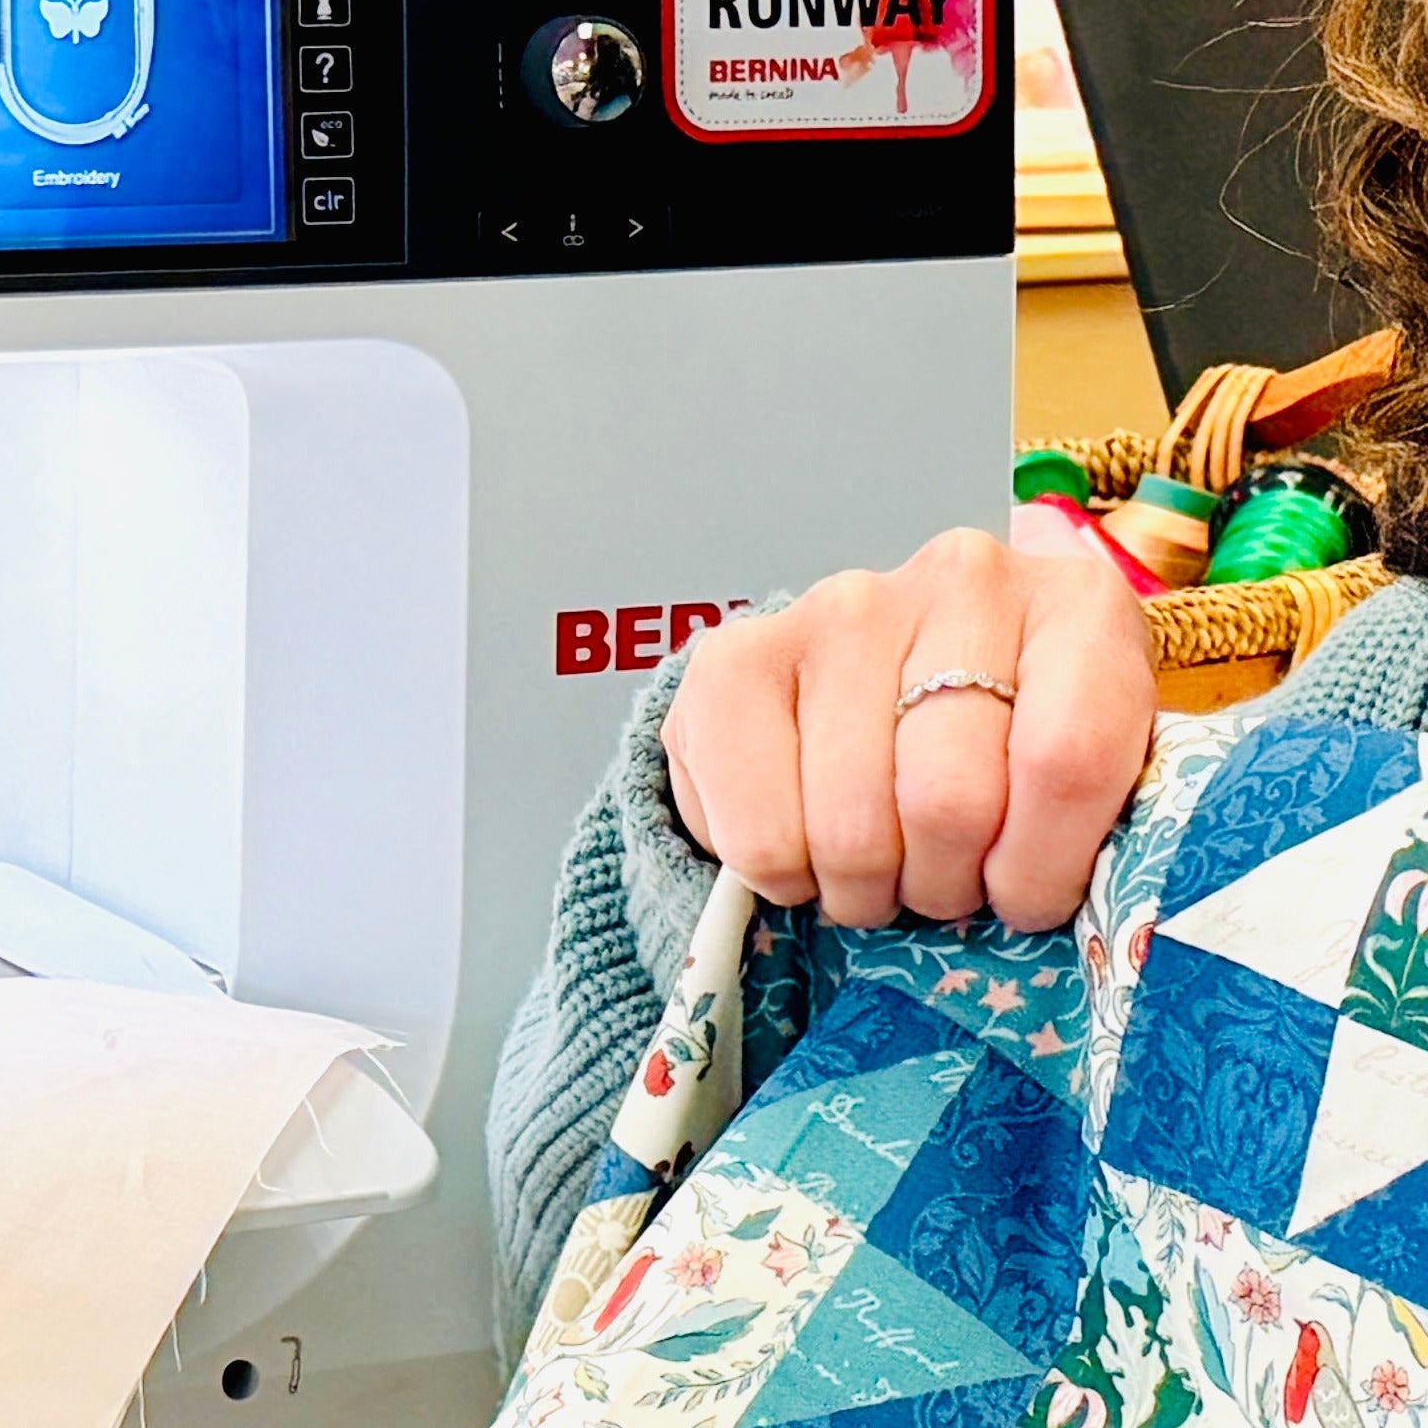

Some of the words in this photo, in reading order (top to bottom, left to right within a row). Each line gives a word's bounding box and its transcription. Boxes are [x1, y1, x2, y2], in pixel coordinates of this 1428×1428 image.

[709, 57, 840, 83] BERNINA
[31, 169, 121, 189] Embroidery
[313, 190, 345, 212] clr
